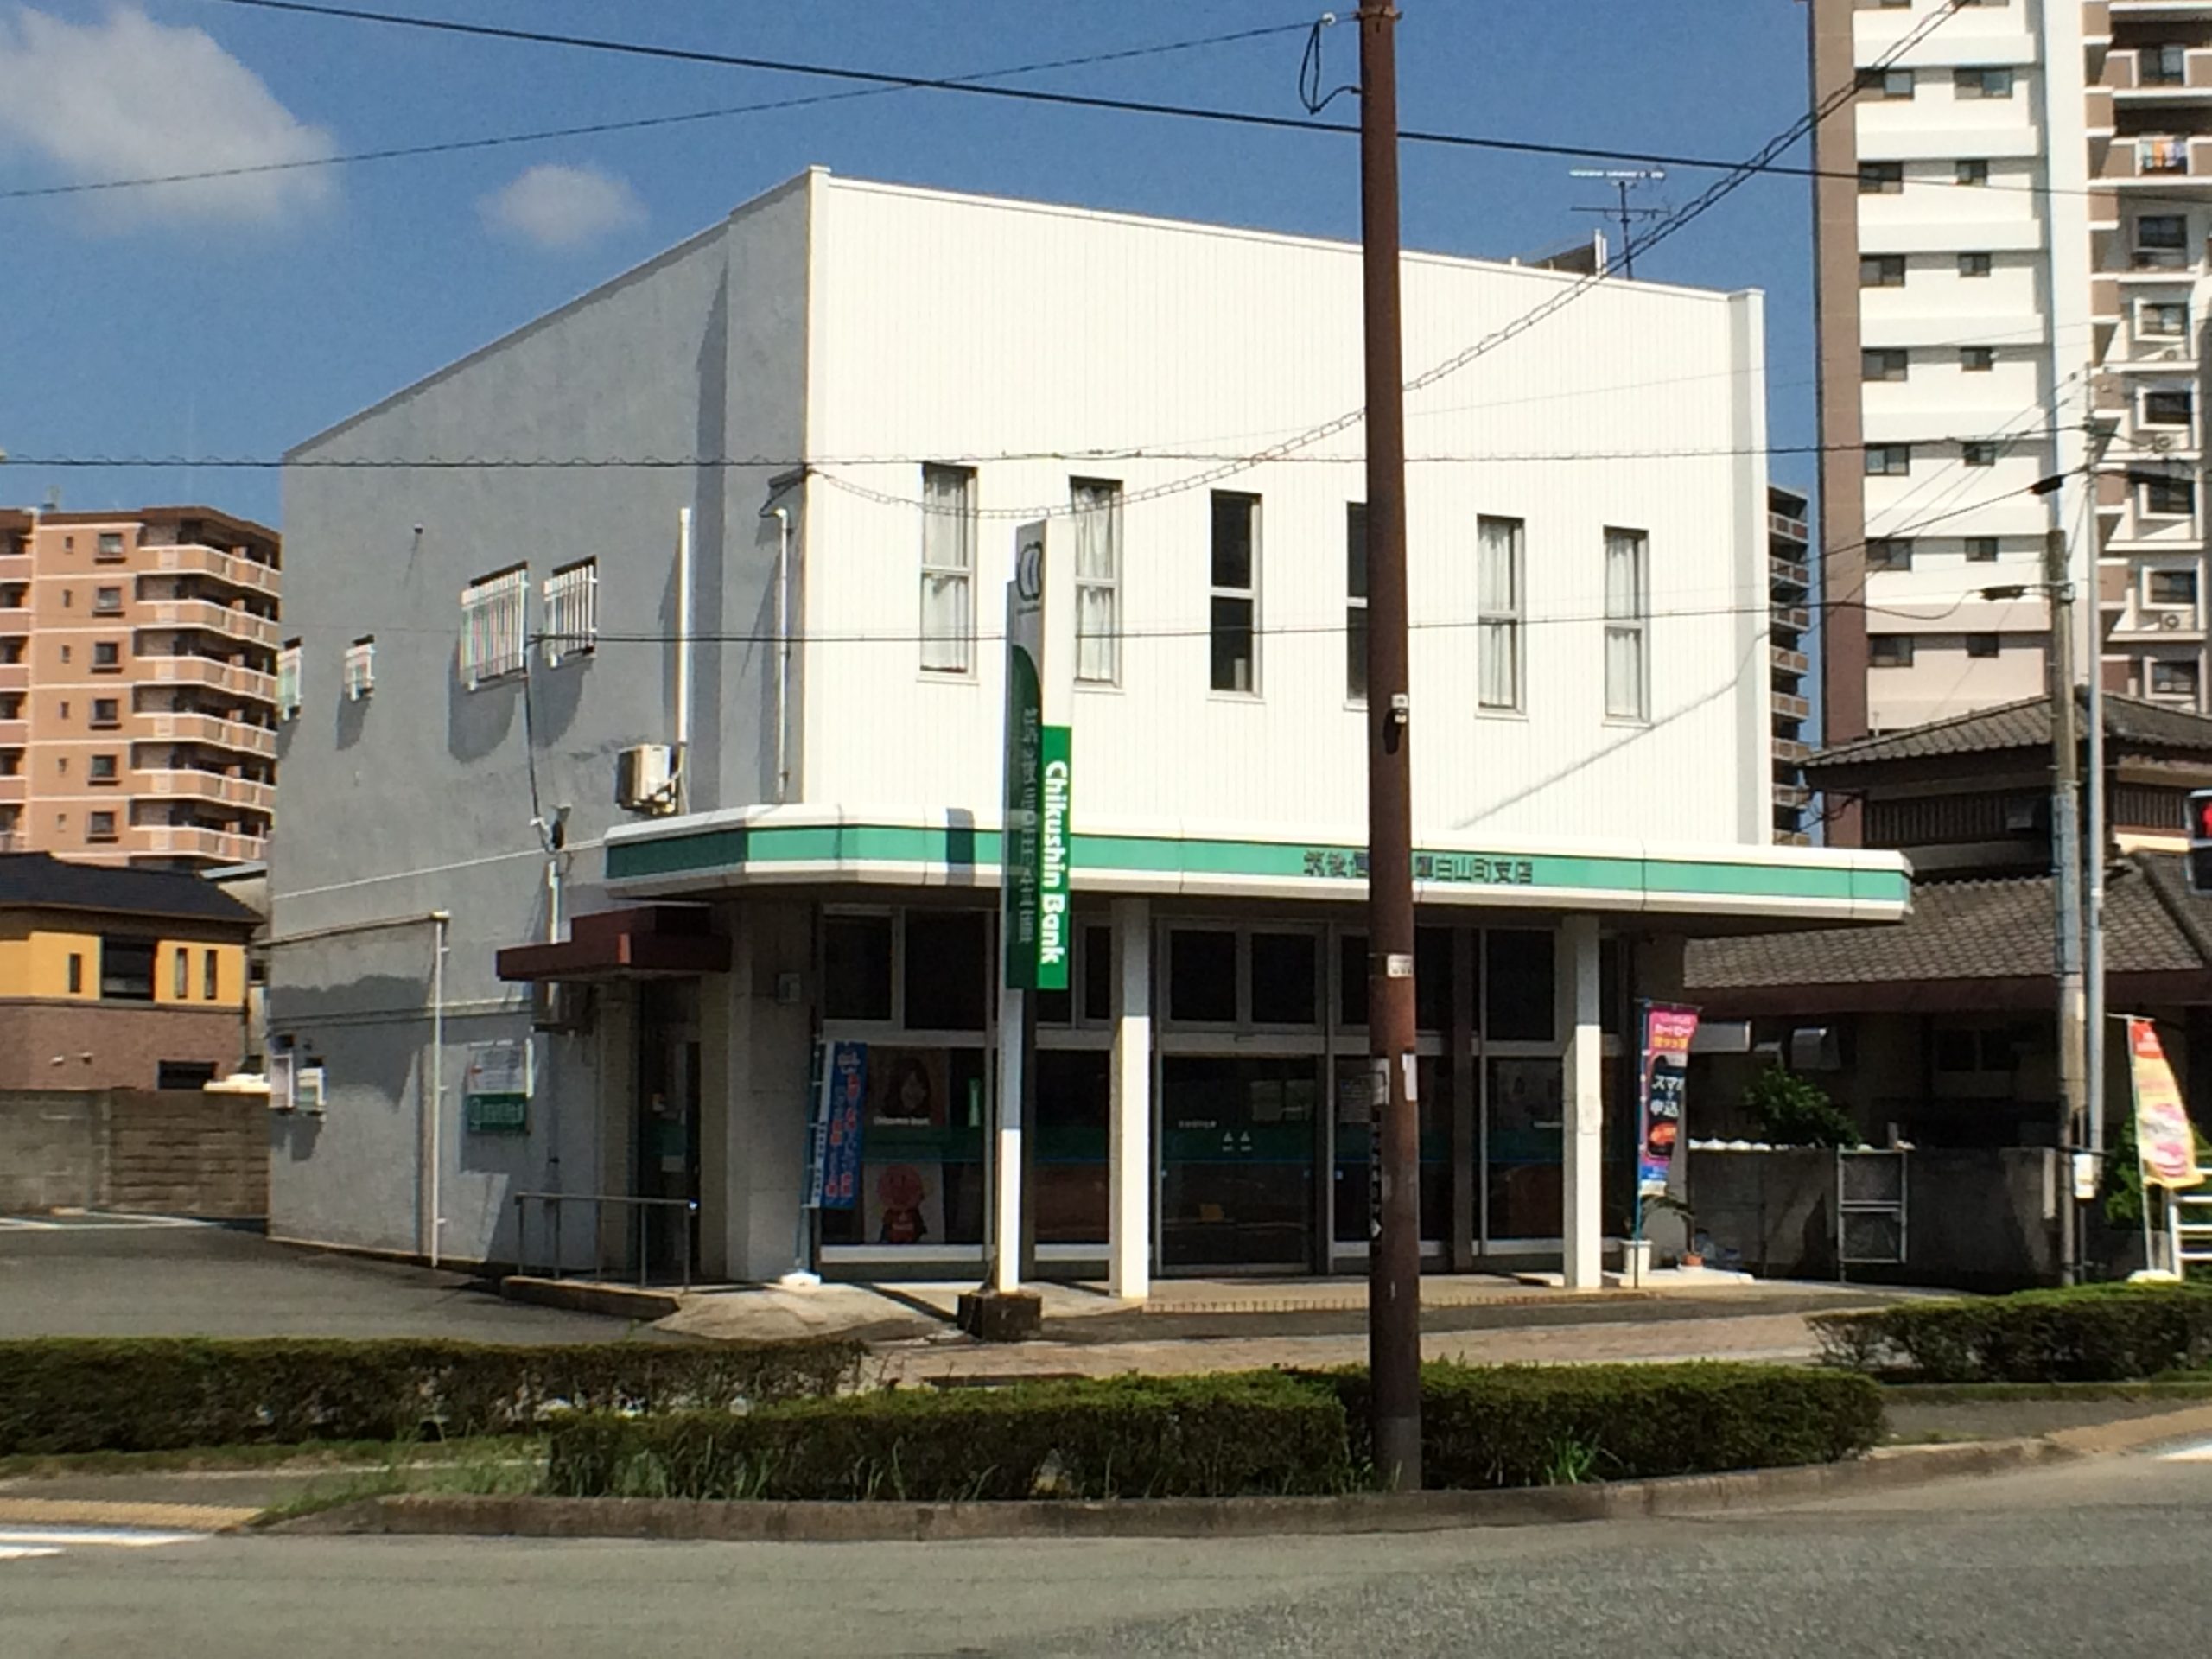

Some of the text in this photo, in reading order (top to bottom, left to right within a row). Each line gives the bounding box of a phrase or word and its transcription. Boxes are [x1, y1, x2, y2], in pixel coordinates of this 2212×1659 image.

[1040, 760, 1068, 964] Chikushin Bank
[1303, 849, 1533, 883] 筑後信庫白山町支店
